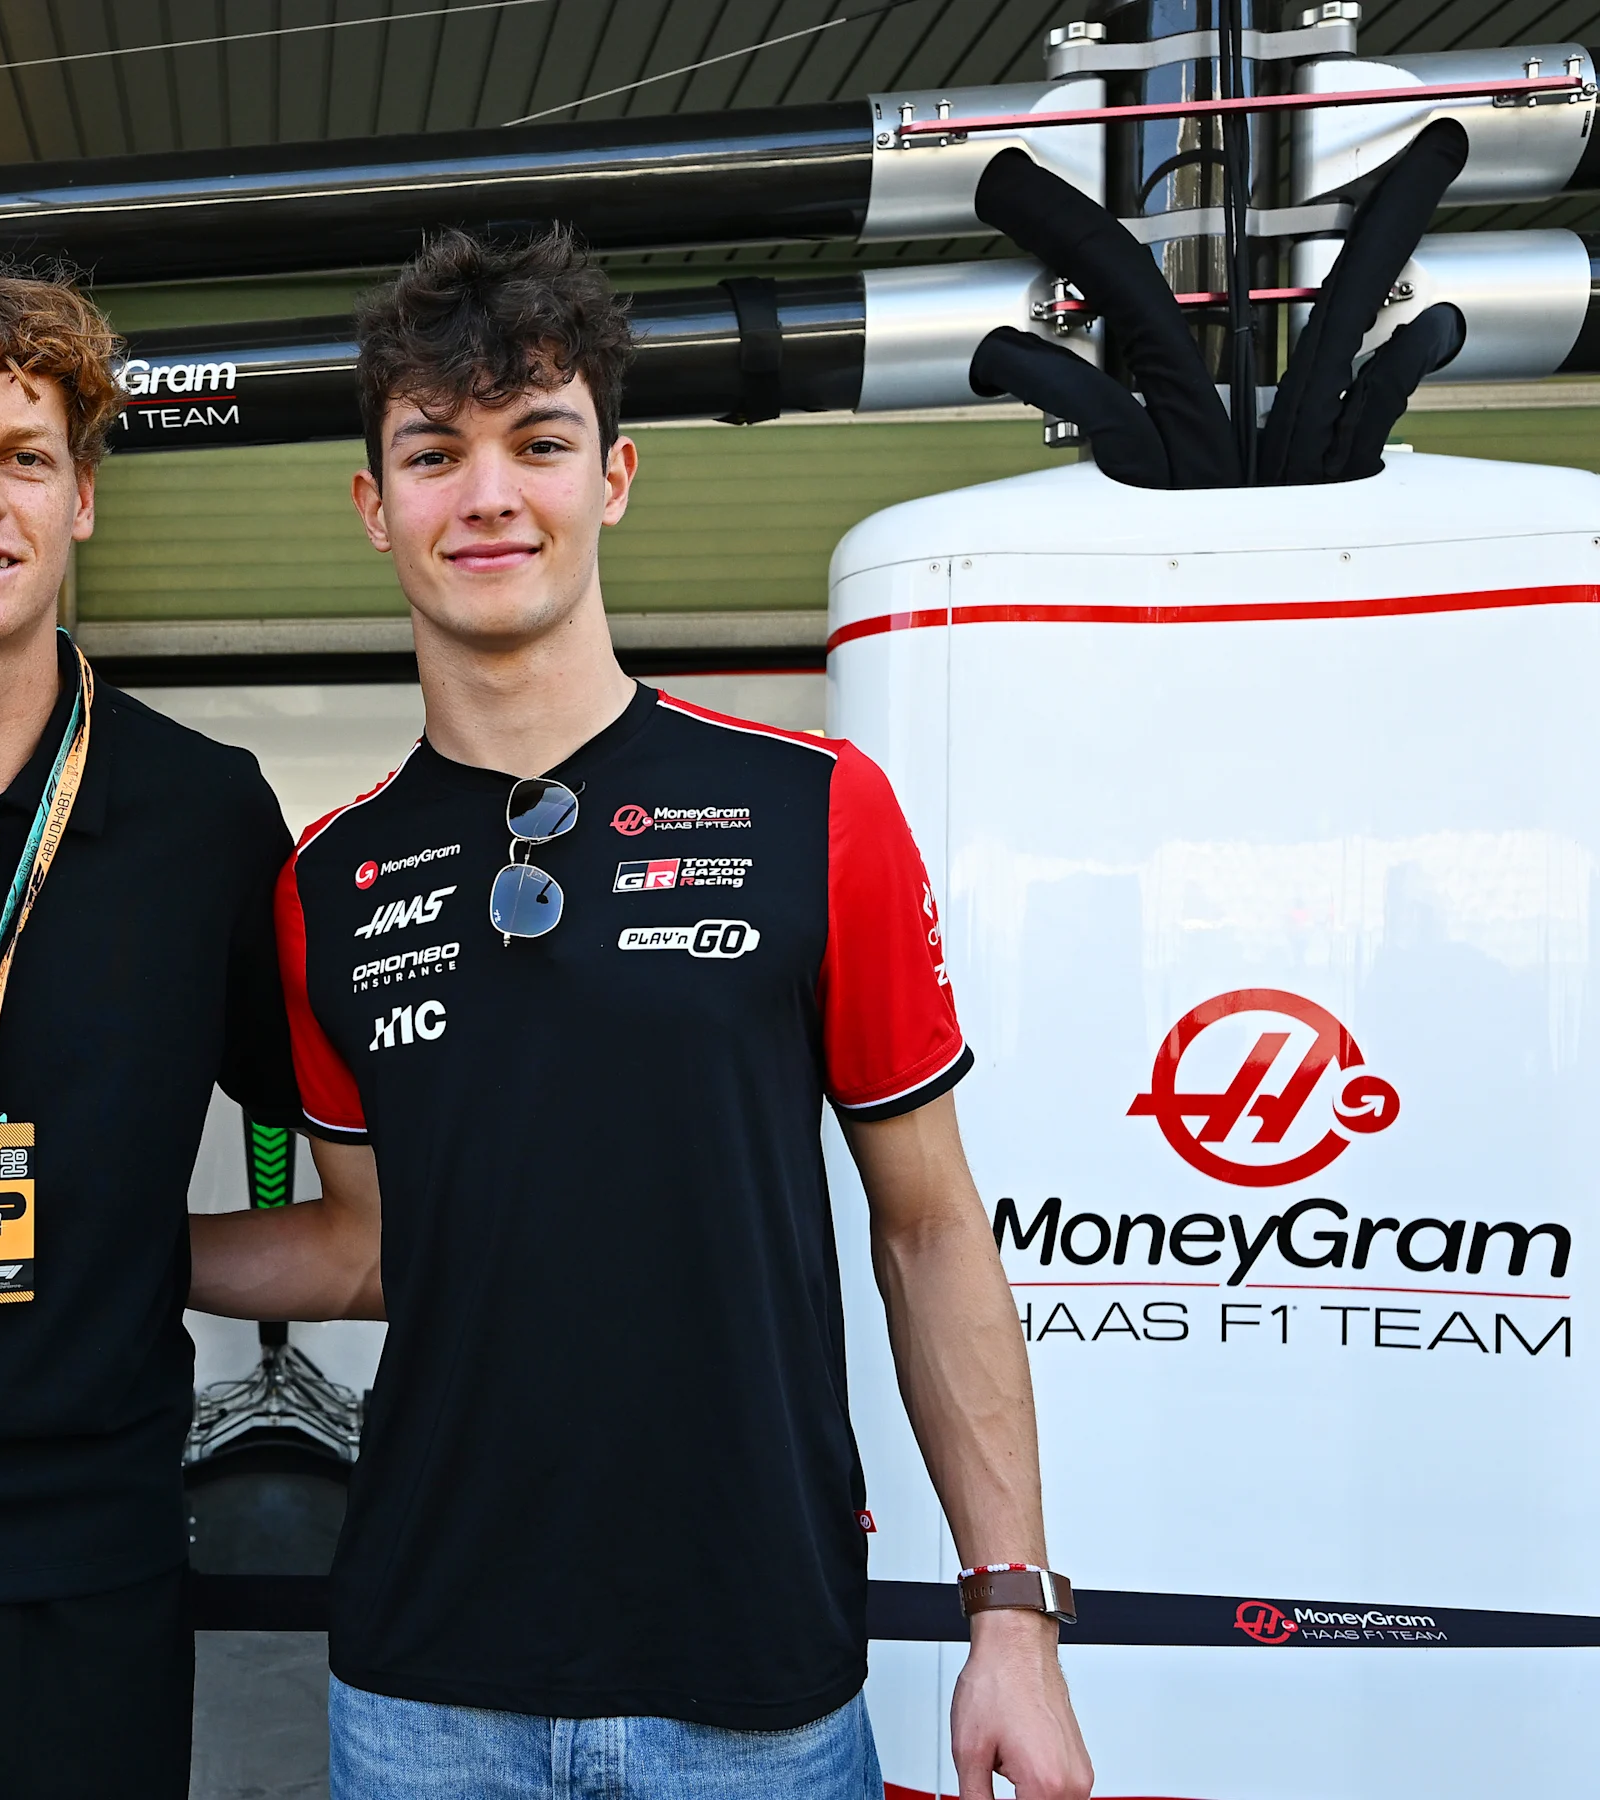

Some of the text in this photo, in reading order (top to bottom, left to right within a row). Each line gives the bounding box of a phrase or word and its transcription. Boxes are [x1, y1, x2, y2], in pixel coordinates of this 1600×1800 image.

[138, 405, 239, 429] TEAM
[654, 807, 750, 820] MoneyGram
[654, 821, 692, 830] HAAS
[712, 821, 751, 829] TEAM
[380, 844, 461, 876] MoneyGram
[683, 858, 753, 867] TOYOTA
[617, 870, 675, 889] GR
[680, 876, 744, 888] Racing
[681, 867, 746, 877] GAZOO
[354, 885, 457, 940] HAAS
[627, 924, 747, 954] PLAY'n GO
[352, 942, 460, 981] ORION180
[353, 960, 456, 993] INSURANCE
[993, 1197, 1572, 1287] MoneyGram
[1221, 1303, 1288, 1344] F1
[1320, 1306, 1571, 1358] TEAM
[1294, 1608, 1436, 1628] MoneyGram
[1302, 1629, 1448, 1641] HAAS F1 TEAM
